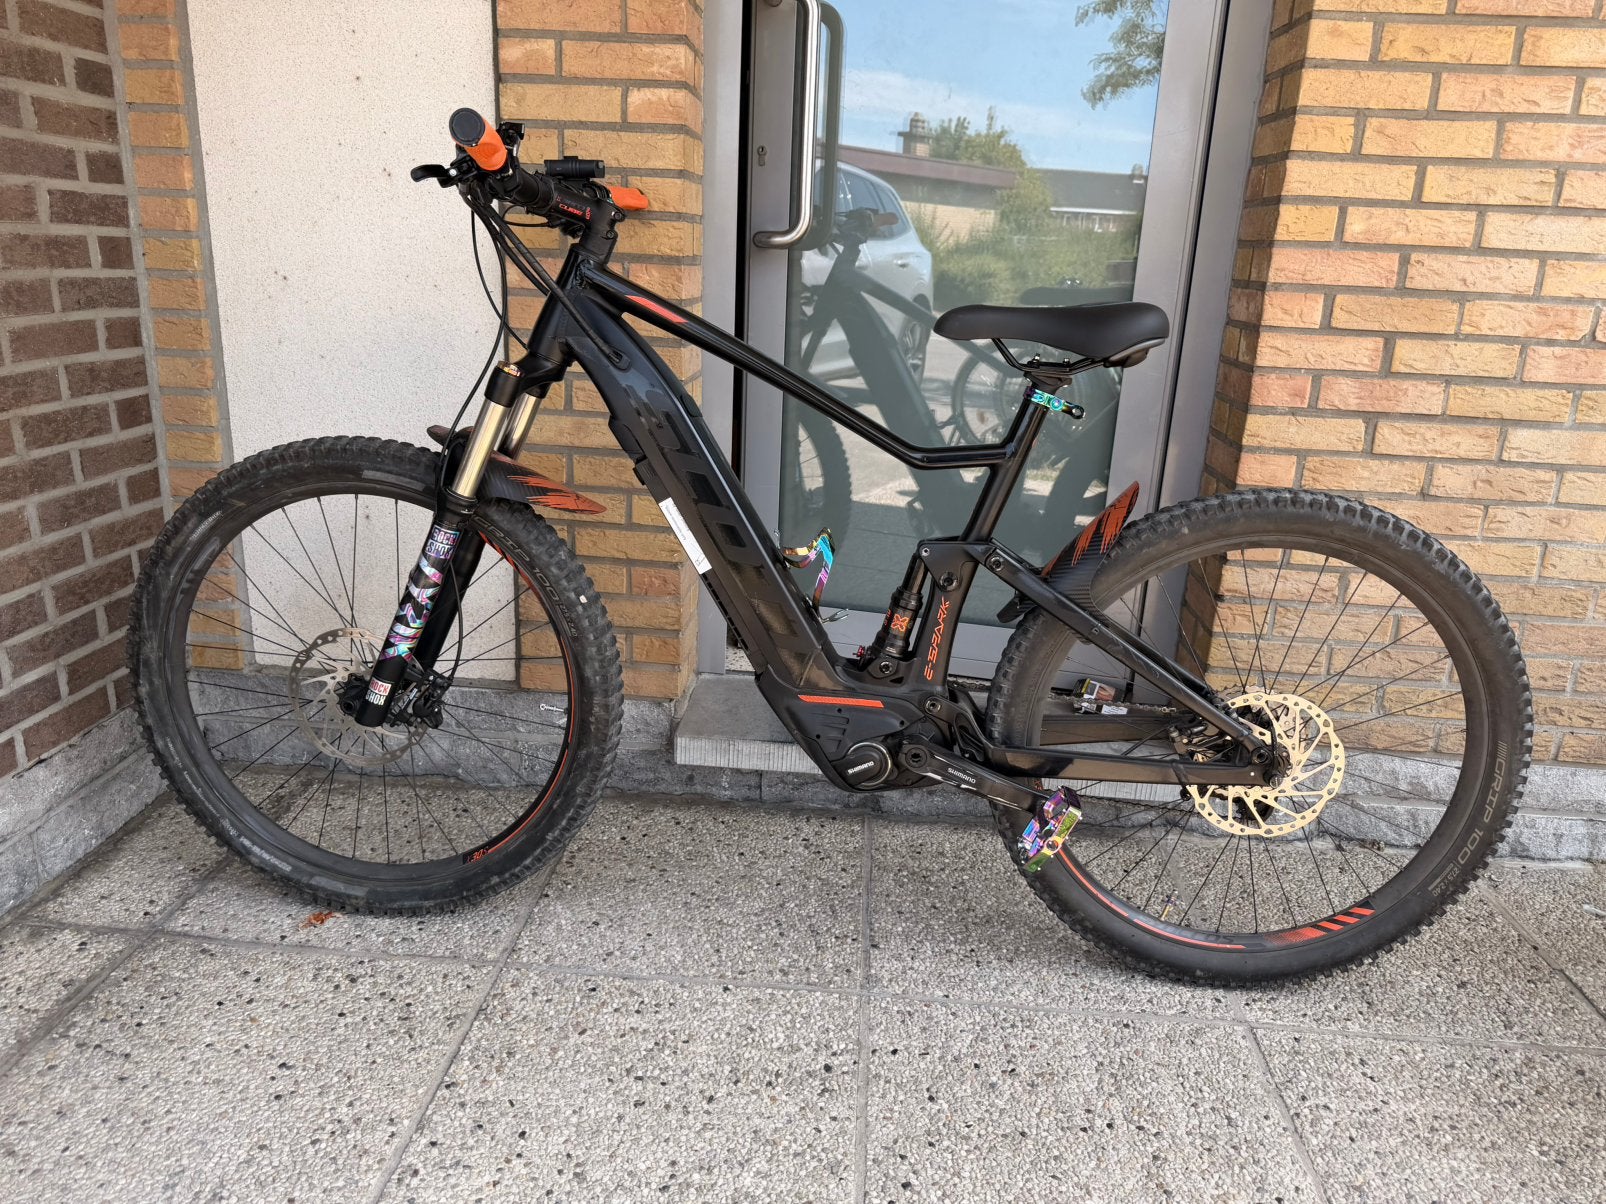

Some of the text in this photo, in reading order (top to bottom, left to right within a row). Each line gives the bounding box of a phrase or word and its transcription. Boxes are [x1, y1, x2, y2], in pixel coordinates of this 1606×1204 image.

[432, 528, 456, 545] ROCK
[427, 541, 456, 559] SHOX
[473, 515, 530, 562] GRIP
[533, 567, 560, 601] 100
[924, 596, 950, 680] E-SPARK
[370, 679, 389, 695] ROCK
[366, 690, 386, 706] SHOX
[847, 761, 875, 775] SHIMANO
[947, 767, 976, 784] SHIMANO
[1483, 758, 1506, 823] GRIP
[1458, 828, 1484, 865] 100
